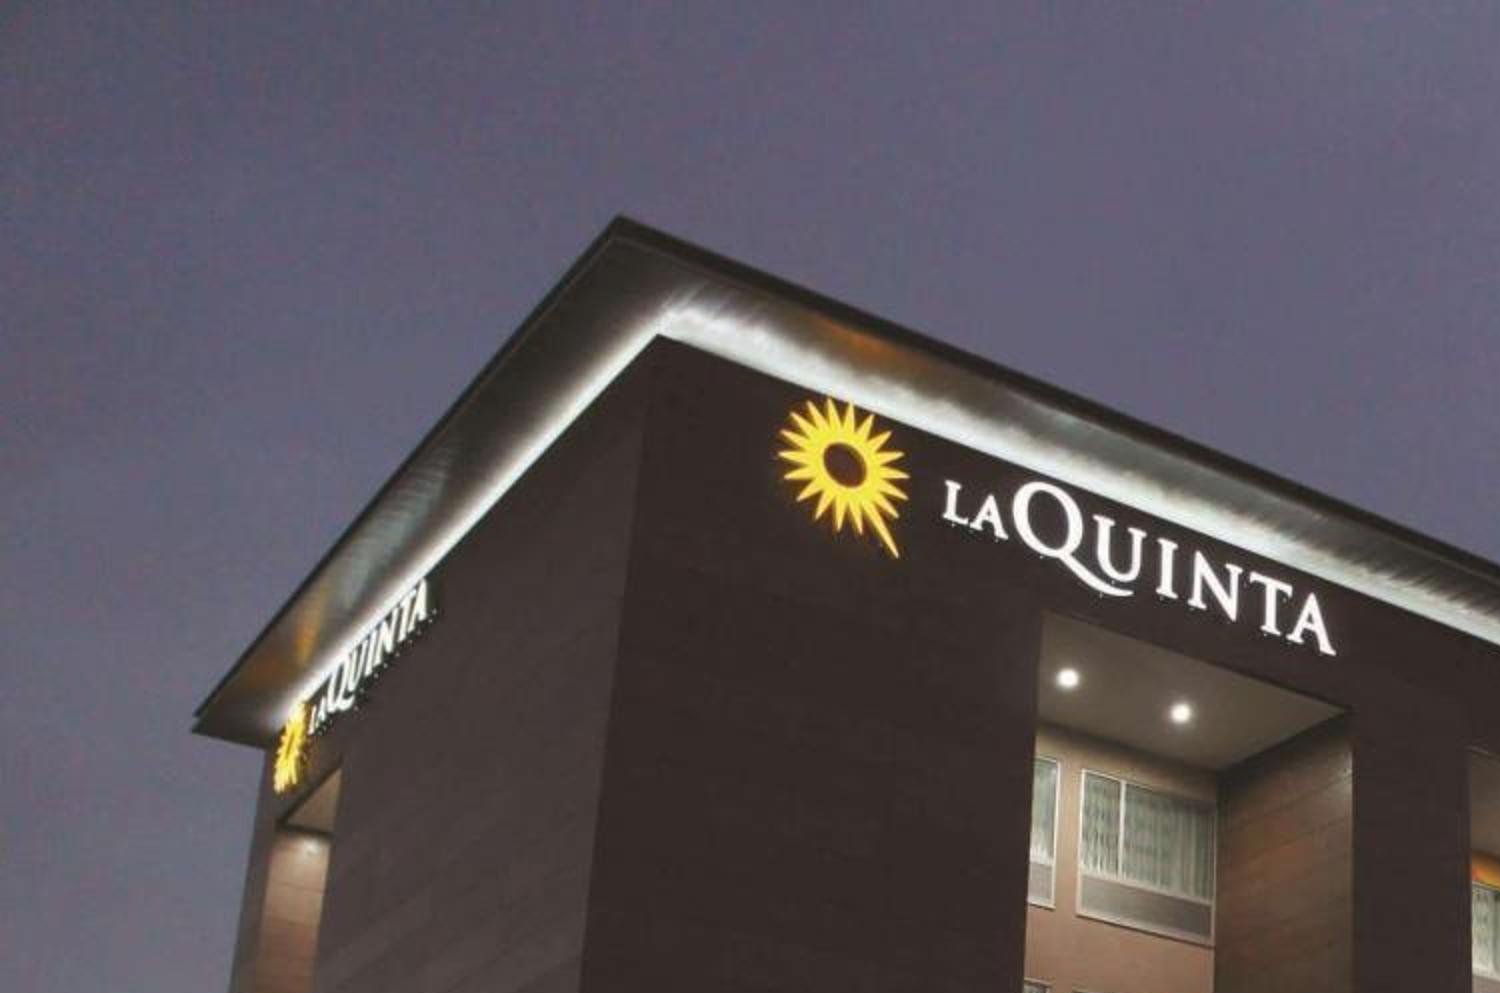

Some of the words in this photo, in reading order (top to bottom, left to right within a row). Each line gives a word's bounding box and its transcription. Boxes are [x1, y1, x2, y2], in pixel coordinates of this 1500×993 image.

[327, 577, 427, 713] QUINTA
[942, 479, 1009, 541] LA
[1012, 481, 1337, 657] QUINTA
